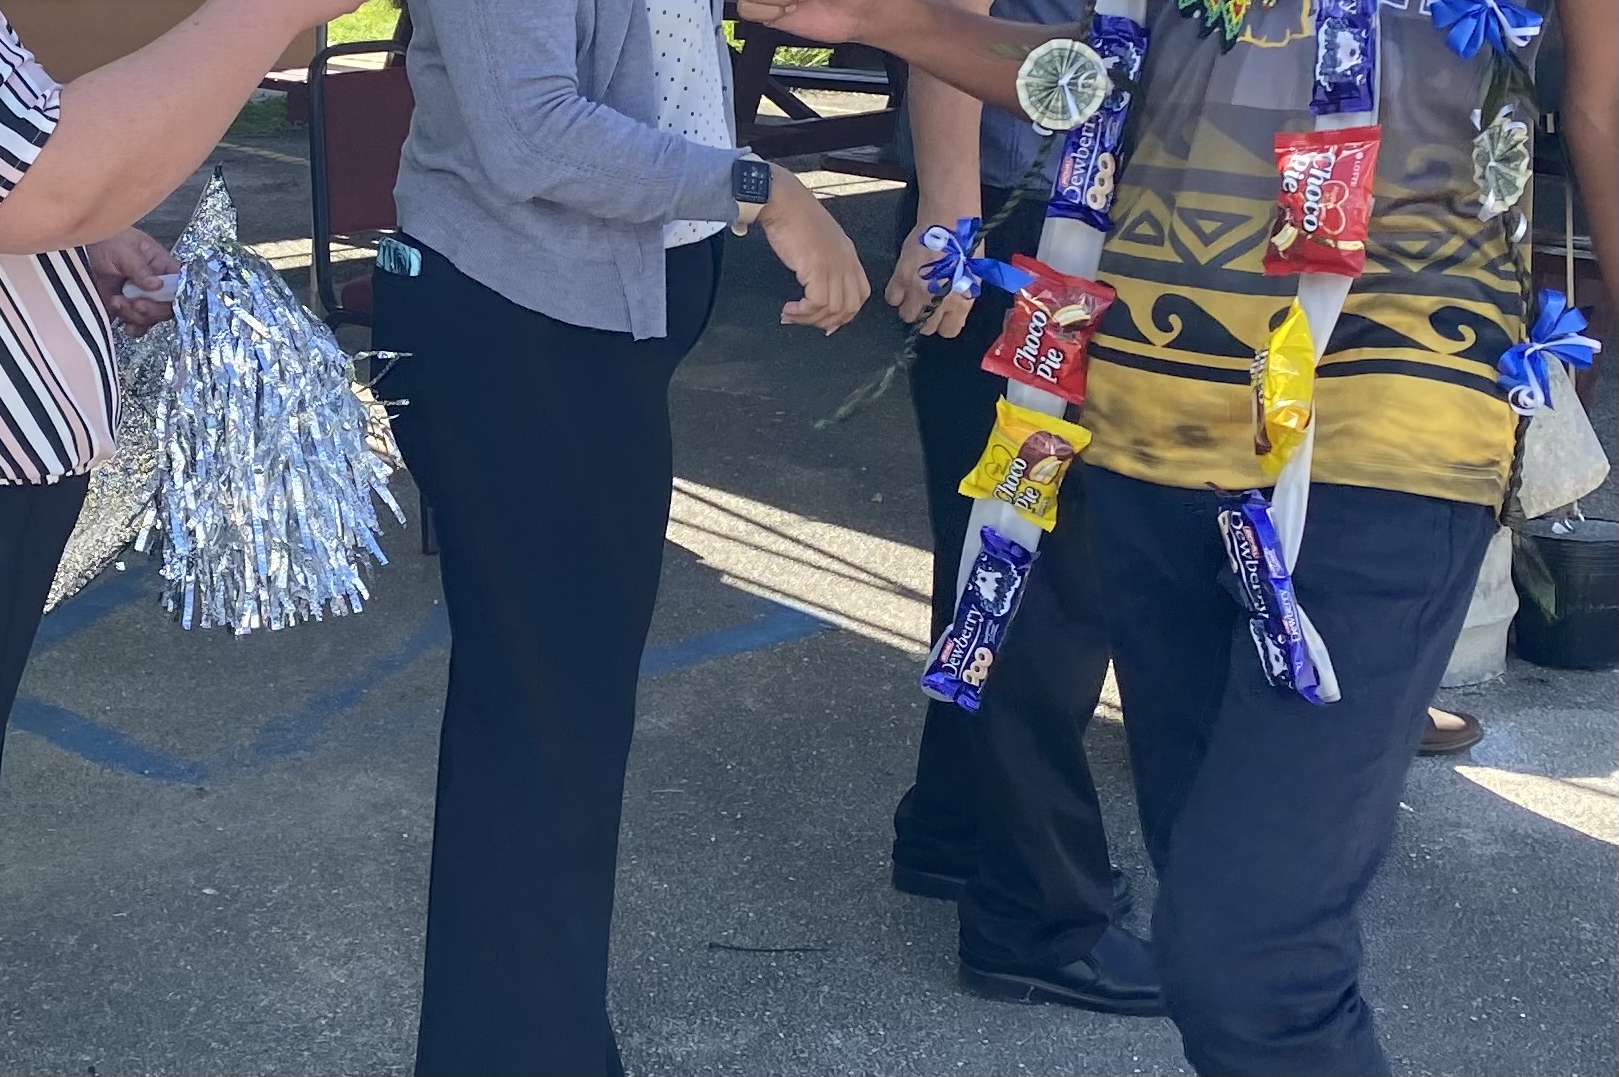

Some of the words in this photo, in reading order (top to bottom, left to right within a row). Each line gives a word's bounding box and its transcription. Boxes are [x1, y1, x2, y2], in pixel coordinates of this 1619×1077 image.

[1282, 152, 1318, 194] Pie
[1303, 145, 1339, 233] Choco
[1013, 310, 1048, 374] Choco
[1036, 348, 1064, 385] Pie
[993, 457, 1027, 503] Choco
[1014, 487, 1040, 513] Pie
[1230, 511, 1270, 619] Dewberry
[941, 603, 984, 679] Dewberry
